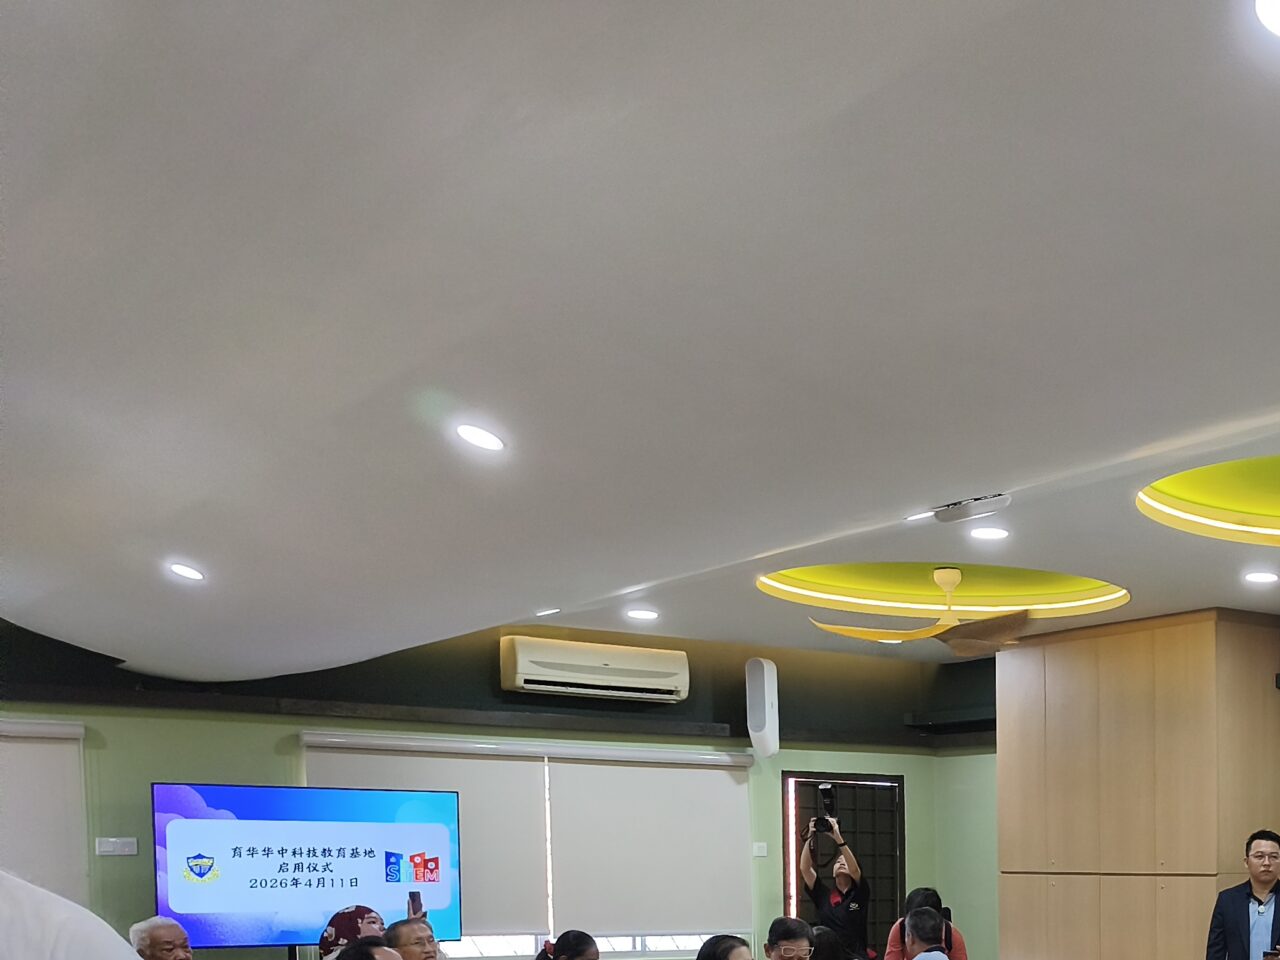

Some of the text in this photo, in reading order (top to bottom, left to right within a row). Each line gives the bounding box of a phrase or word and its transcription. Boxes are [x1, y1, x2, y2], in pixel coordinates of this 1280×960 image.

[231, 846, 376, 859] 育华华中科技教育基地
[277, 861, 334, 874] 启用仪式
[387, 865, 440, 882] STEM
[249, 876, 359, 889] 2026年4月11日
